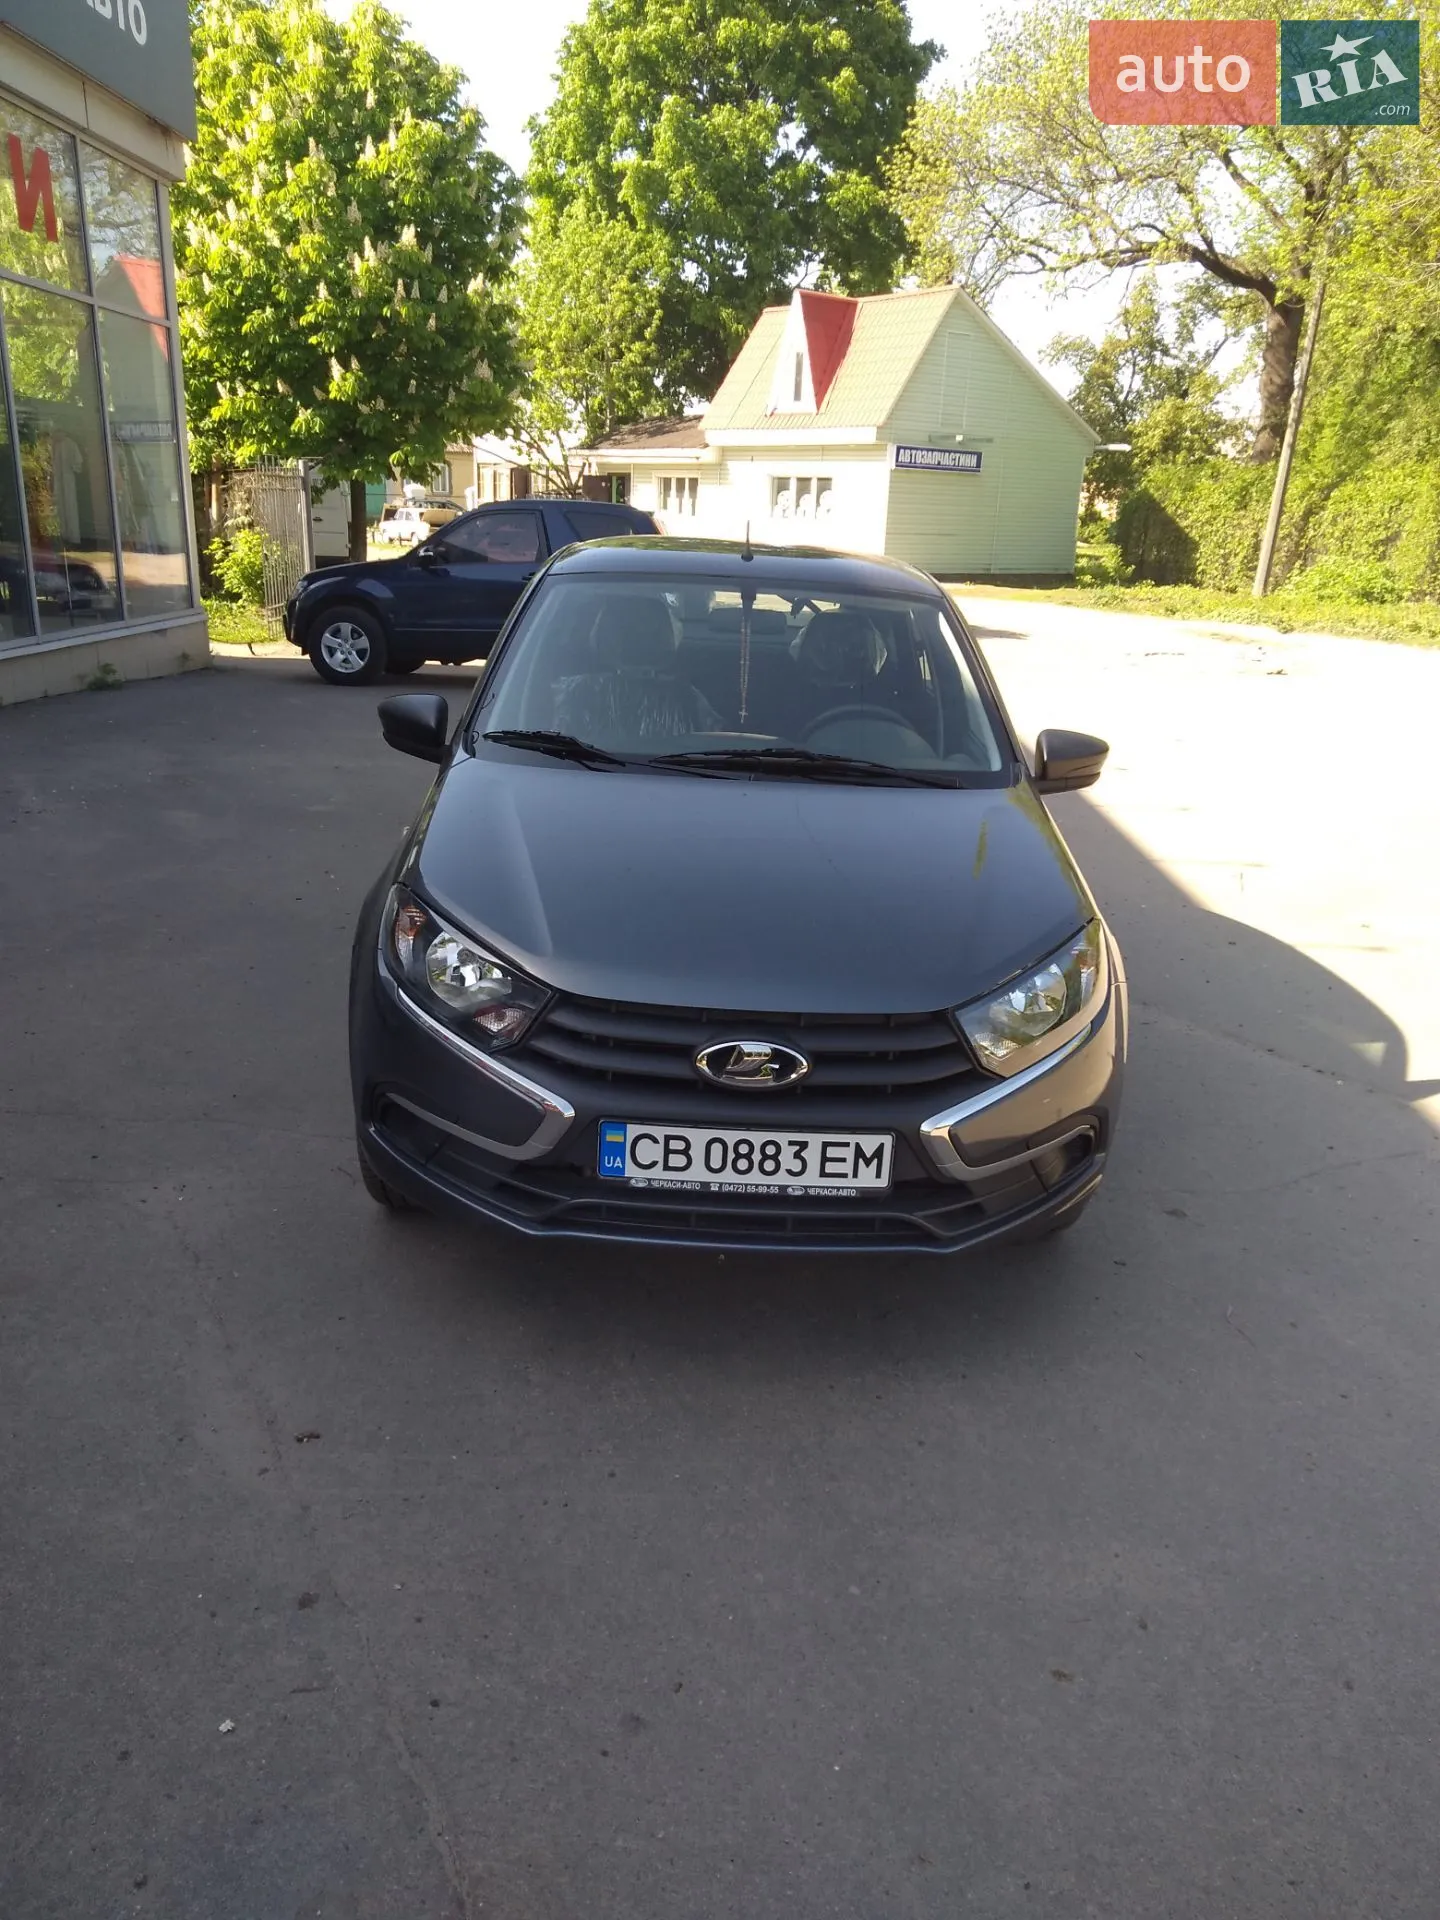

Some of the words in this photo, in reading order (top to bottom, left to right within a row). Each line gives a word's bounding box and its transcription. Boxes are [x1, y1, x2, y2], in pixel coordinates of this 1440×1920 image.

[898, 449, 977, 467] АВТОЗАПЧАСТИНИ
[604, 1155, 623, 1169] UA
[704, 1136, 809, 1178] 0883
[650, 1179, 701, 1190] ЧЕРКАСИ-АВТО
[806, 1187, 857, 1197] ЧЕРКАСИ-АВТО
